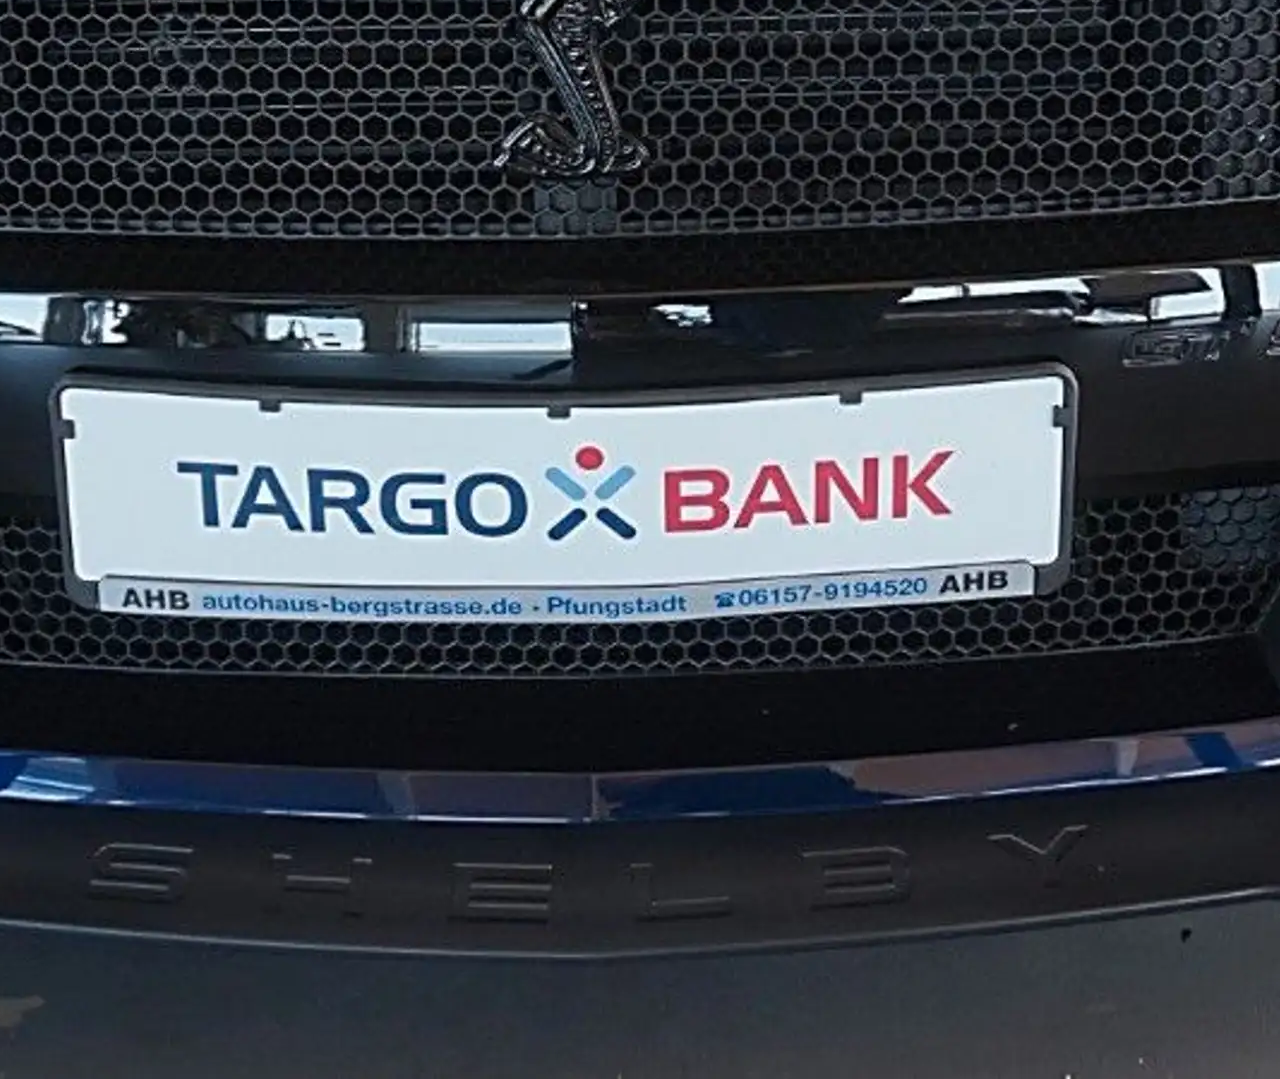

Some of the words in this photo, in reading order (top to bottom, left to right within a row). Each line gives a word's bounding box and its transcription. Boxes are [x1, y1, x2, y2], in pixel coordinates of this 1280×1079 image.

[176, 460, 529, 538] TARGO
[663, 450, 956, 534] BANK
[122, 588, 191, 611] AHB
[202, 591, 523, 618] autohaus-bergstrasse.de
[546, 594, 687, 619] Pfungstadt
[737, 577, 928, 608] 06157-9194520
[939, 570, 1009, 596] AHB
